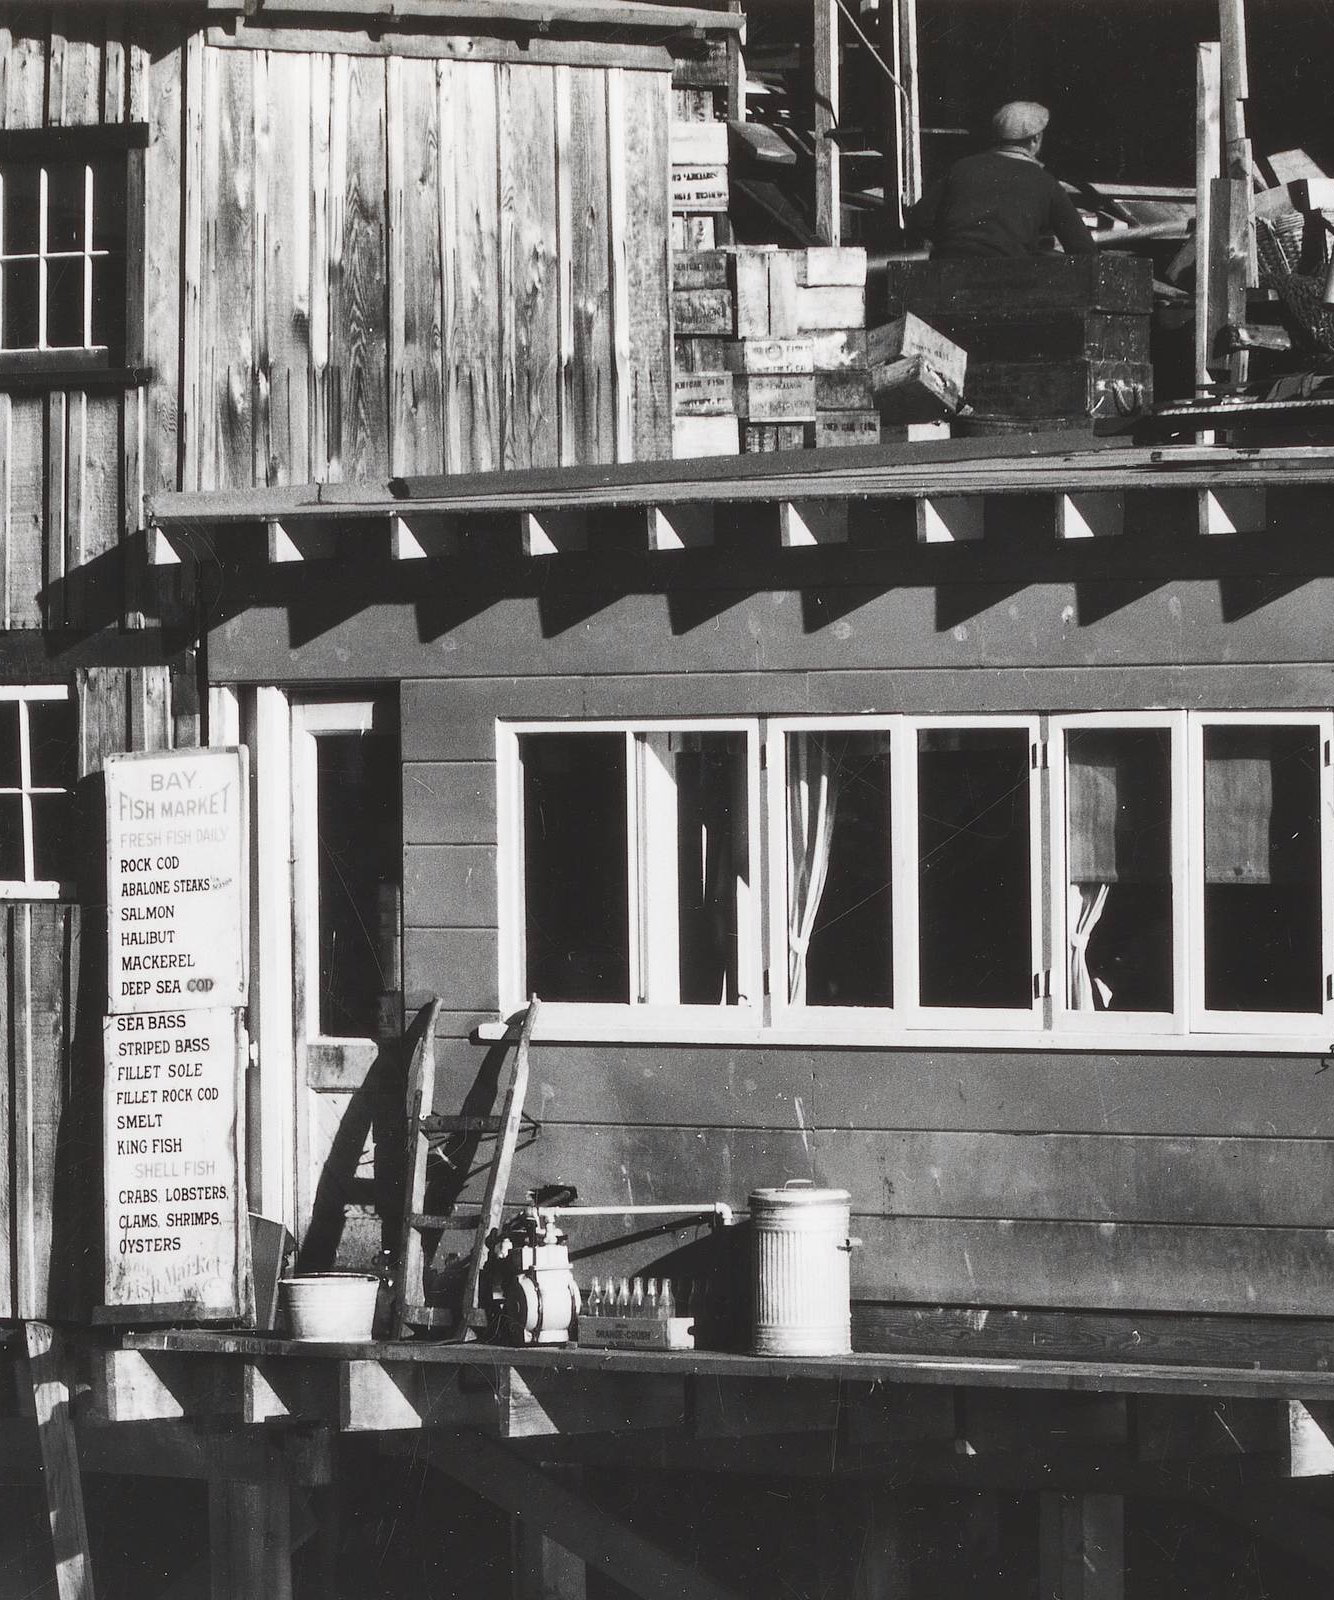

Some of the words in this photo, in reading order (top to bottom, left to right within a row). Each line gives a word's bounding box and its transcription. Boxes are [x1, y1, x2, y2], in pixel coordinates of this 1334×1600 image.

[151, 770, 198, 792] BAY
[119, 791, 156, 822] FISH
[160, 782, 231, 819] MARKET
[120, 831, 162, 849] FRESH
[166, 829, 192, 846] FISH
[196, 826, 229, 843] DAILY
[120, 858, 152, 873] ROCK
[156, 855, 180, 872] COD
[121, 880, 170, 897] ABALONE
[173, 878, 210, 893] STEAKS
[121, 905, 175, 921] SALMON
[121, 930, 176, 947] HALIBUT
[121, 953, 196, 971] MACKEREL
[121, 980, 152, 997] DEEP
[156, 979, 182, 994] SEA
[186, 977, 214, 993] COD
[117, 1017, 145, 1032] SEA
[148, 1014, 187, 1031] BASS
[118, 1041, 171, 1057] STRIPED
[175, 1038, 210, 1053] BASS
[117, 1065, 161, 1081] FILLET
[167, 1063, 204, 1078] SOLE
[116, 1091, 159, 1105] FILLET
[162, 1089, 193, 1104] ROCK
[197, 1087, 219, 1102] COD
[117, 1114, 163, 1130] SMELT
[117, 1139, 148, 1155] KING
[152, 1137, 183, 1153] FISH
[135, 1162, 178, 1179] SHELL
[184, 1160, 215, 1176] FISH
[119, 1237, 181, 1255] OYSTERS
